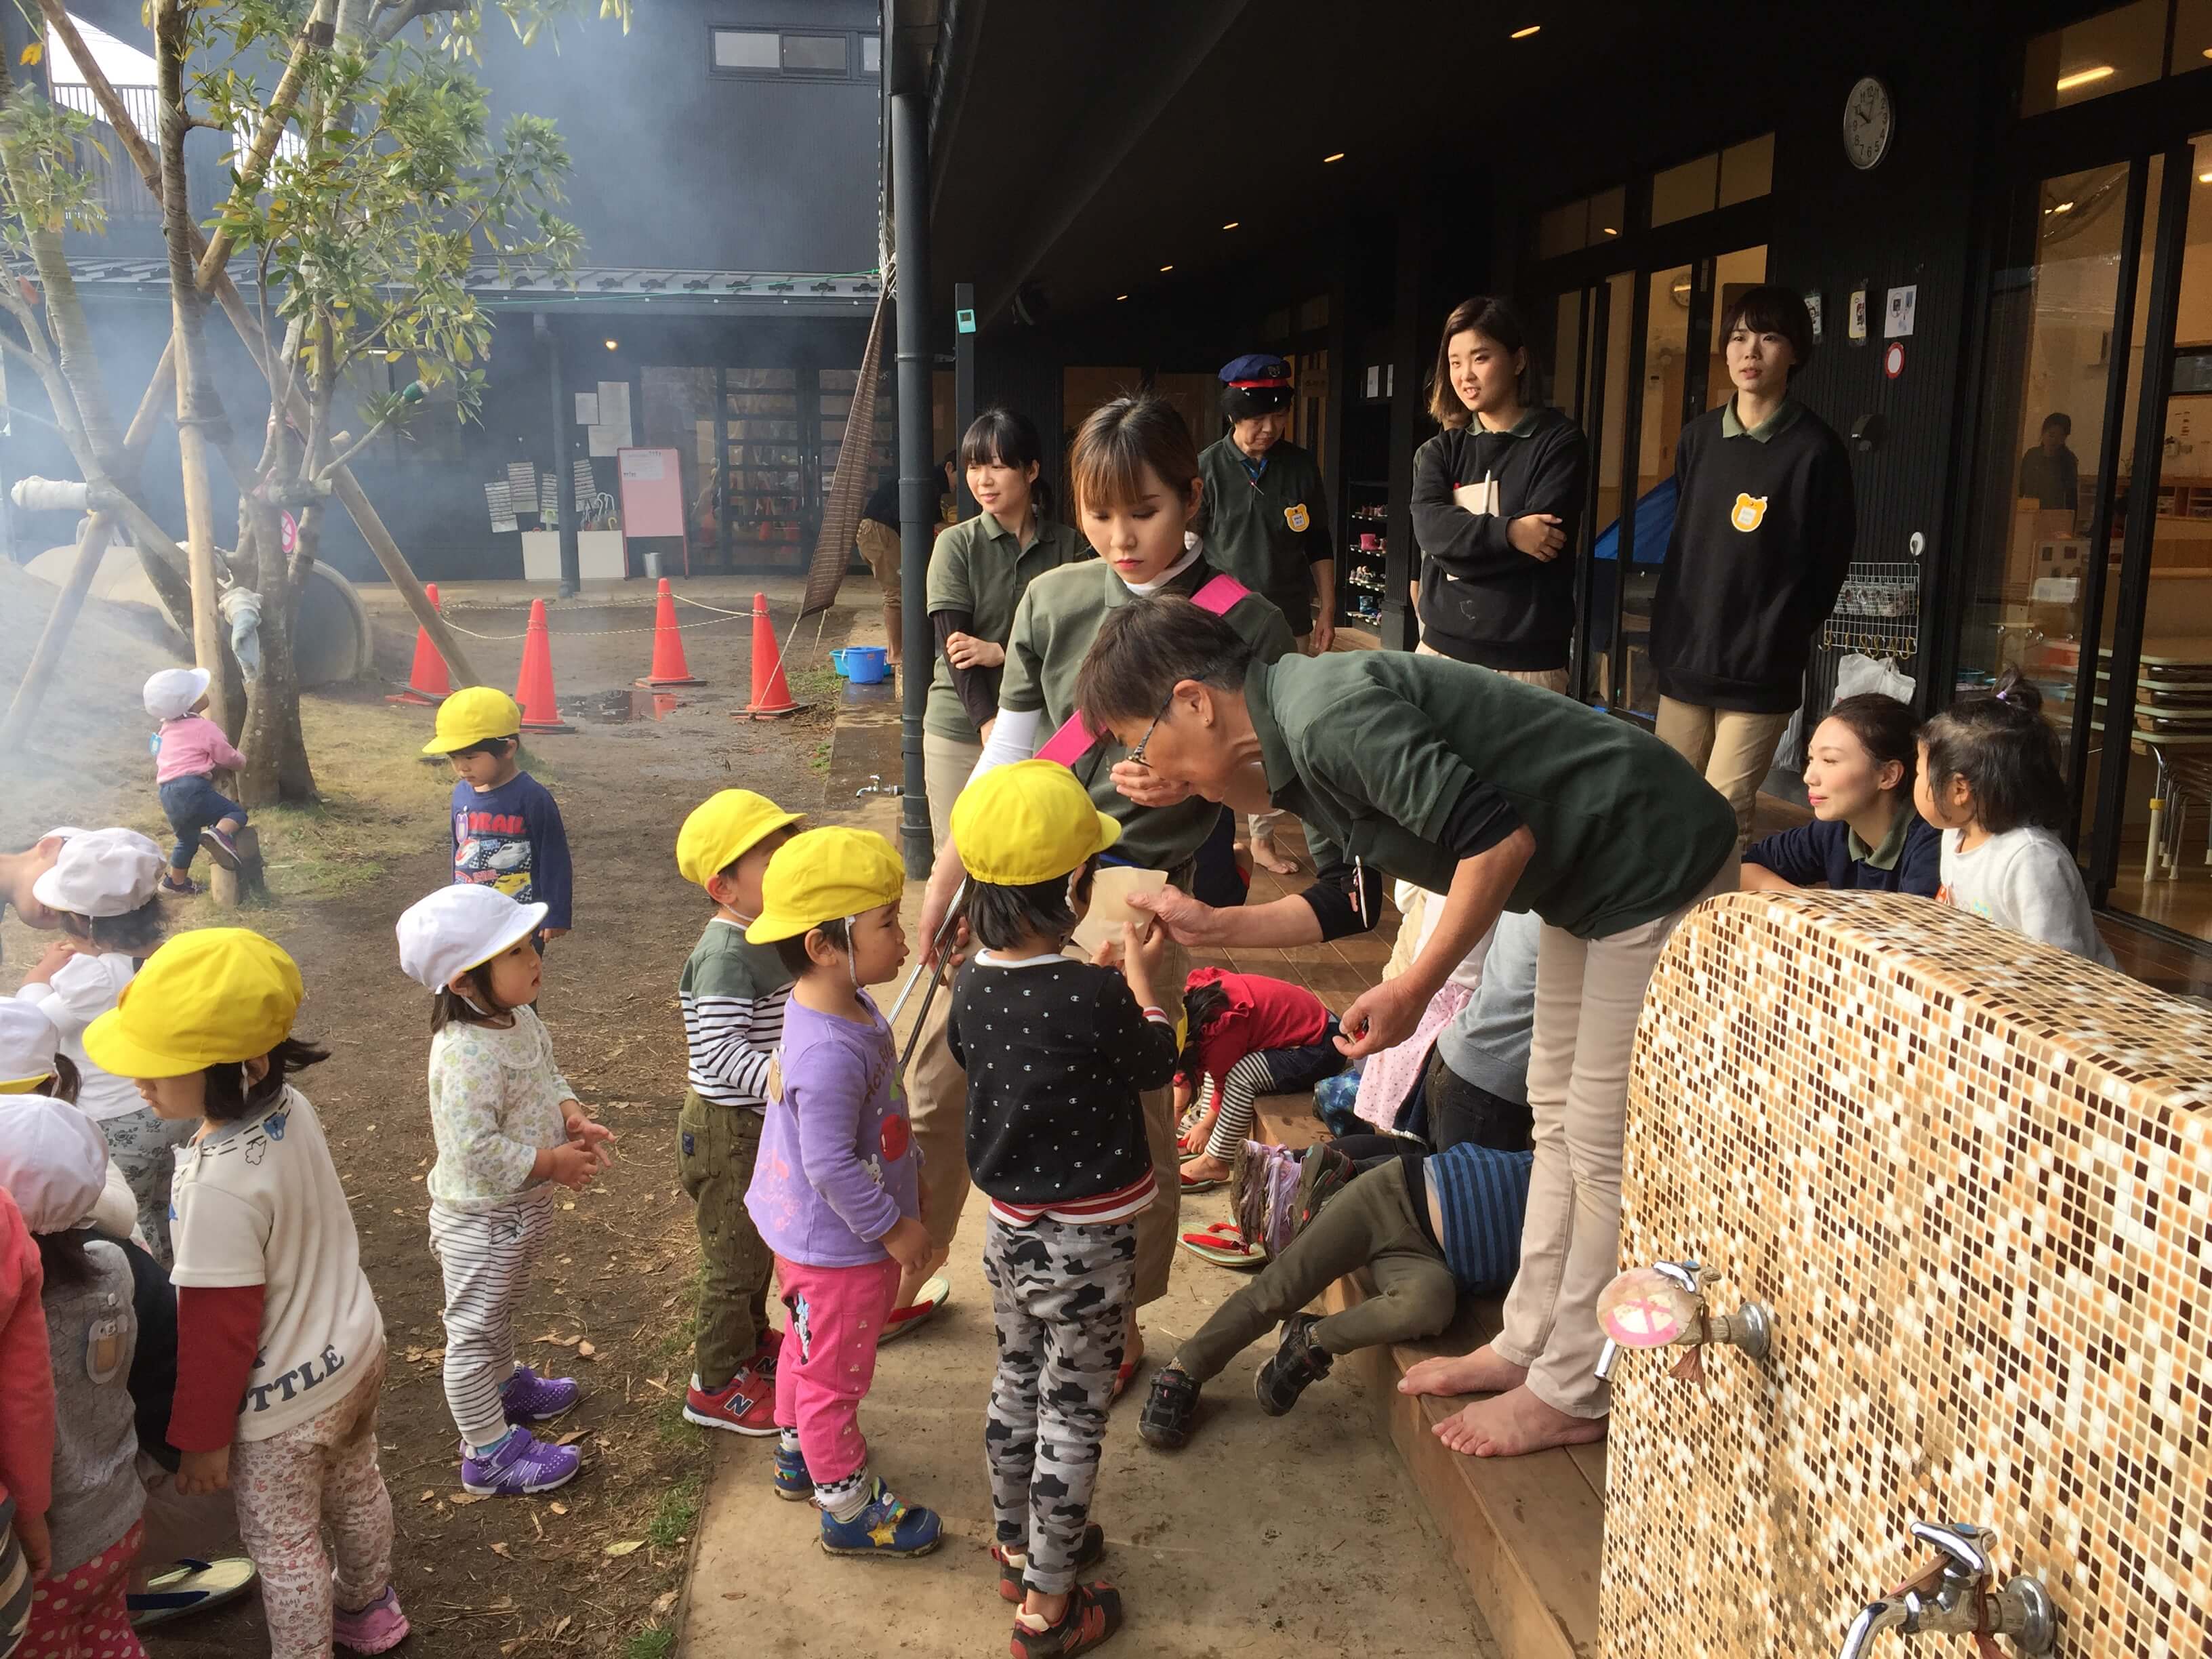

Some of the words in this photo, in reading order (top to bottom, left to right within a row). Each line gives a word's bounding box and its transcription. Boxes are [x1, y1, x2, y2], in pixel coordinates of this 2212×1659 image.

[1860, 89, 1865, 103] 11
[1881, 98, 1885, 108] 2
[1882, 112, 1887, 125] 3
[1853, 120, 1858, 131] 9
[1854, 134, 1860, 146] 8
[1880, 129, 1885, 140] 4
[1860, 144, 1864, 156] 7
[1867, 146, 1872, 157] 6
[1875, 141, 1879, 152] 5
[724, 1393, 754, 1417] N
